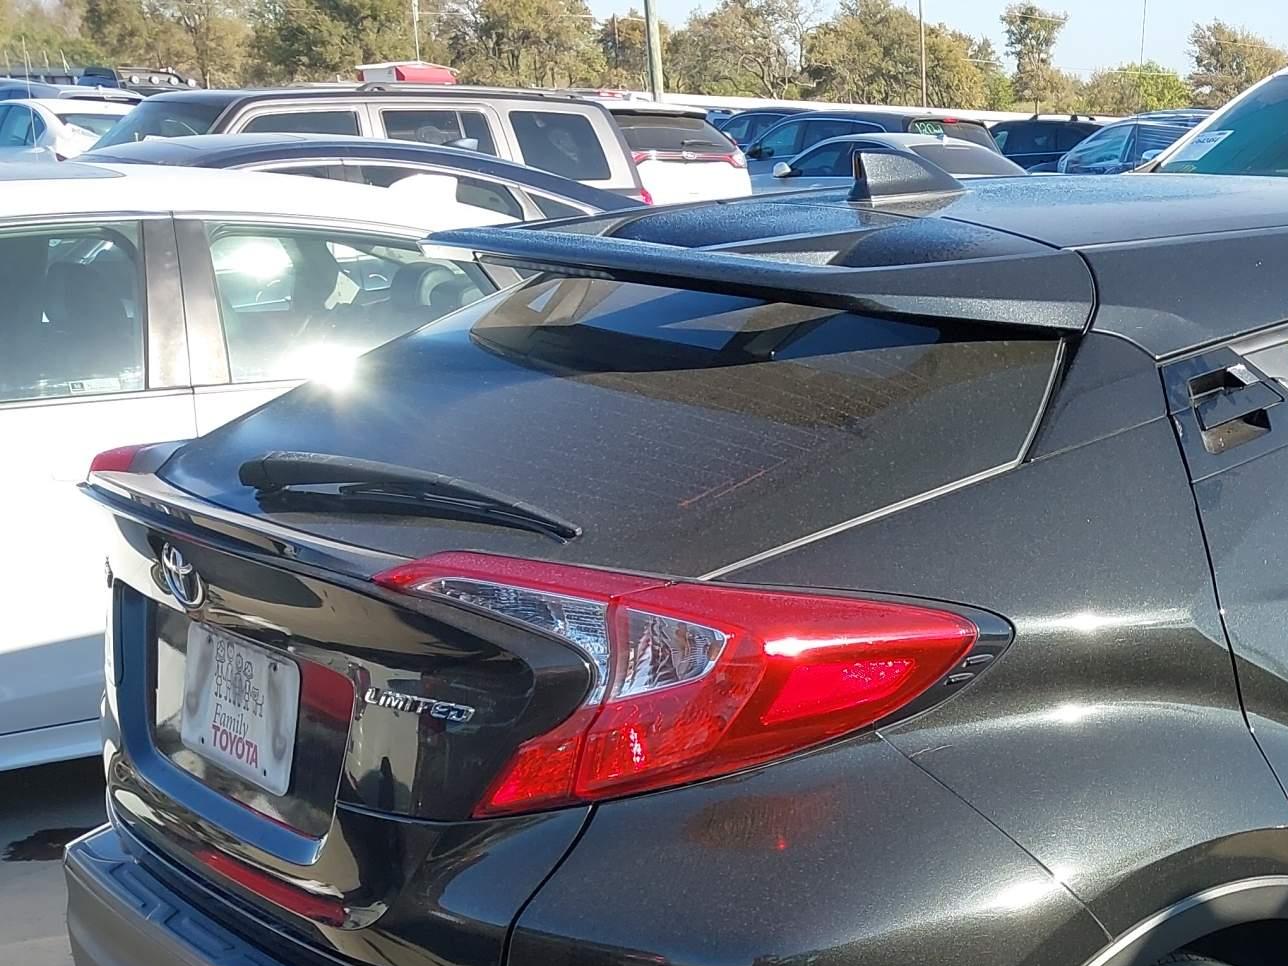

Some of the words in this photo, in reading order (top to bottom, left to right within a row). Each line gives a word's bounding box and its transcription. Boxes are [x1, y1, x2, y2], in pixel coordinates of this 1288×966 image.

[213, 702, 249, 739] Family
[364, 687, 476, 722] LIMITED
[212, 723, 258, 769] TOYOTA
